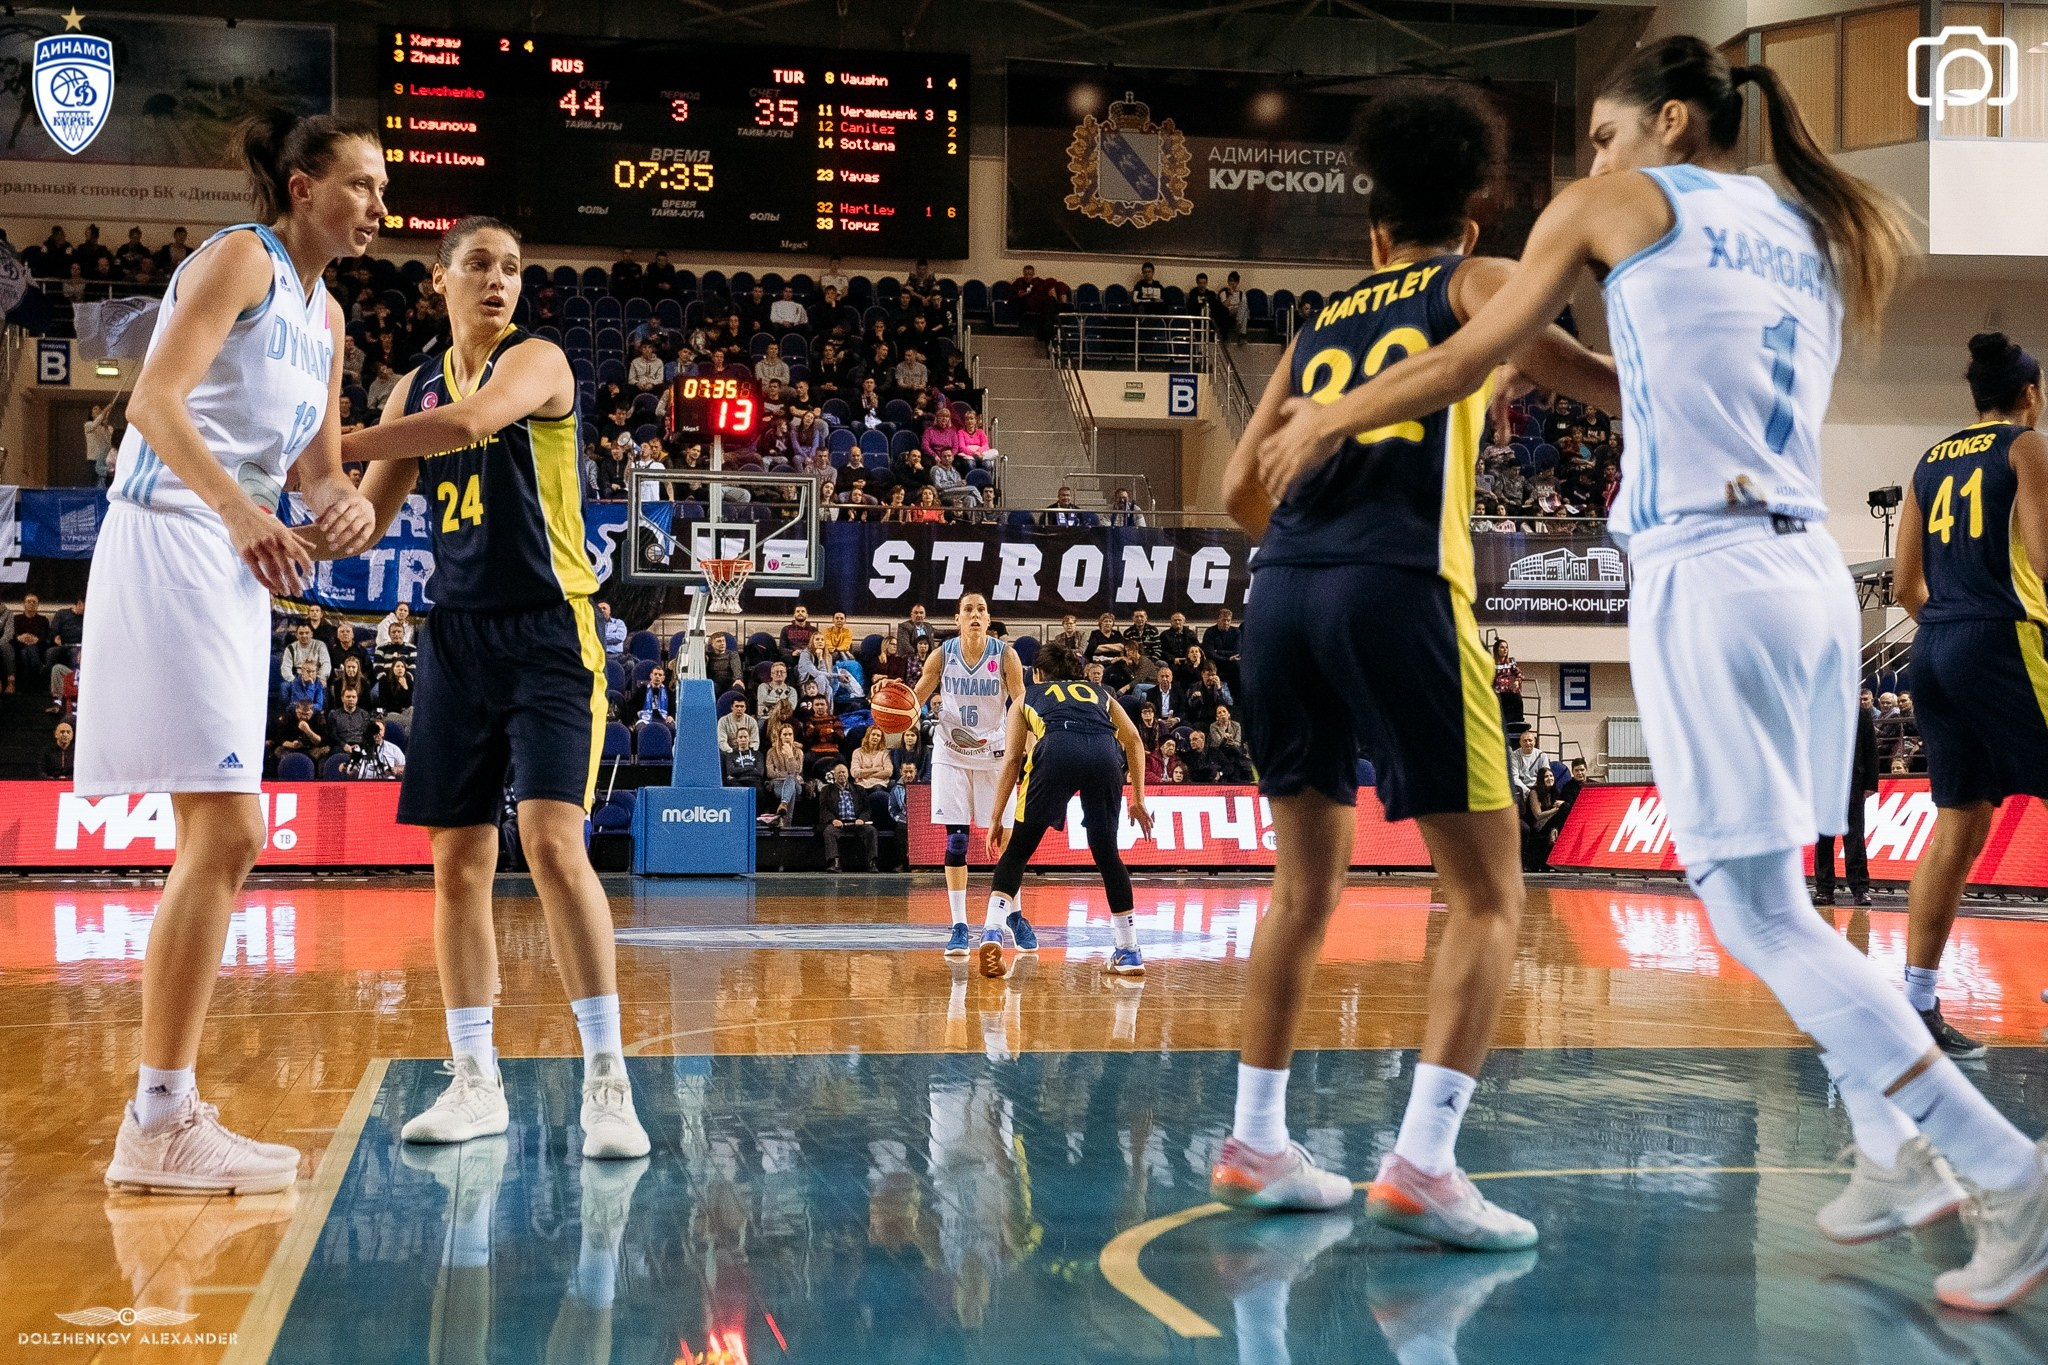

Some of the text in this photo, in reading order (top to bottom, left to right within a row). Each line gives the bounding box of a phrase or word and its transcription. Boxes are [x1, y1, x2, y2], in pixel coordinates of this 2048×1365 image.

[396, 33, 402, 45] 1
[500, 39, 509, 51] 2
[524, 40, 534, 52] 4
[394, 49, 459, 65] 3 Zhedik
[551, 58, 583, 73] RUS
[773, 70, 805, 83] TUR
[825, 72, 957, 89] 8 Vaughn 1 4
[395, 83, 484, 98] 9 Levchenko
[578, 79, 611, 91] СЧЕТ
[749, 88, 781, 98] СЧЕТ
[560, 89, 604, 117] 44
[660, 91, 700, 100] ПЕРИОД
[672, 100, 687, 121] 3
[755, 99, 798, 126] 35
[819, 104, 957, 122] 11 Verameyenk 3 5
[387, 116, 476, 132] 11 Logunova
[565, 120, 623, 131] ТАЙМ-АУТЫ
[819, 121, 956, 137] 12 Canitez 2
[737, 128, 794, 138] ТАЙМ-АУТЫ
[818, 137, 956, 154] 14 Sottana 2
[386, 149, 484, 166] 13 Kirillova
[650, 148, 711, 163] ВРЕМЯ
[615, 159, 713, 191] 07:35
[817, 169, 879, 183] 23 Yavas
[1209, 168, 1374, 195] КУРСКОЙ О
[81, 185, 148, 200] спонсор
[153, 185, 174, 199] БК
[577, 205, 609, 215] ФОЛЫ
[662, 200, 696, 209] ВРЕМЯ
[817, 202, 955, 219] 32 Hartley 1 6
[651, 208, 705, 218] ТАЙМ-АУТА
[749, 212, 780, 222] ФОЛЫ
[384, 215, 404, 229] 33
[817, 218, 879, 231] 33 Topuz
[1315, 265, 1442, 331] HARTLEY
[1763, 316, 1797, 455] 1
[718, 399, 753, 431] 13
[1927, 434, 1997, 463] STOKES
[437, 474, 484, 533] 24
[1928, 468, 1983, 543] 41
[1485, 597, 1632, 613] СПОРТИВНО-КОНЦЕРТ
[944, 676, 1000, 696] DYNAMO
[1045, 684, 1099, 705] 10
[959, 705, 979, 727] 15
[662, 806, 731, 823] molten
